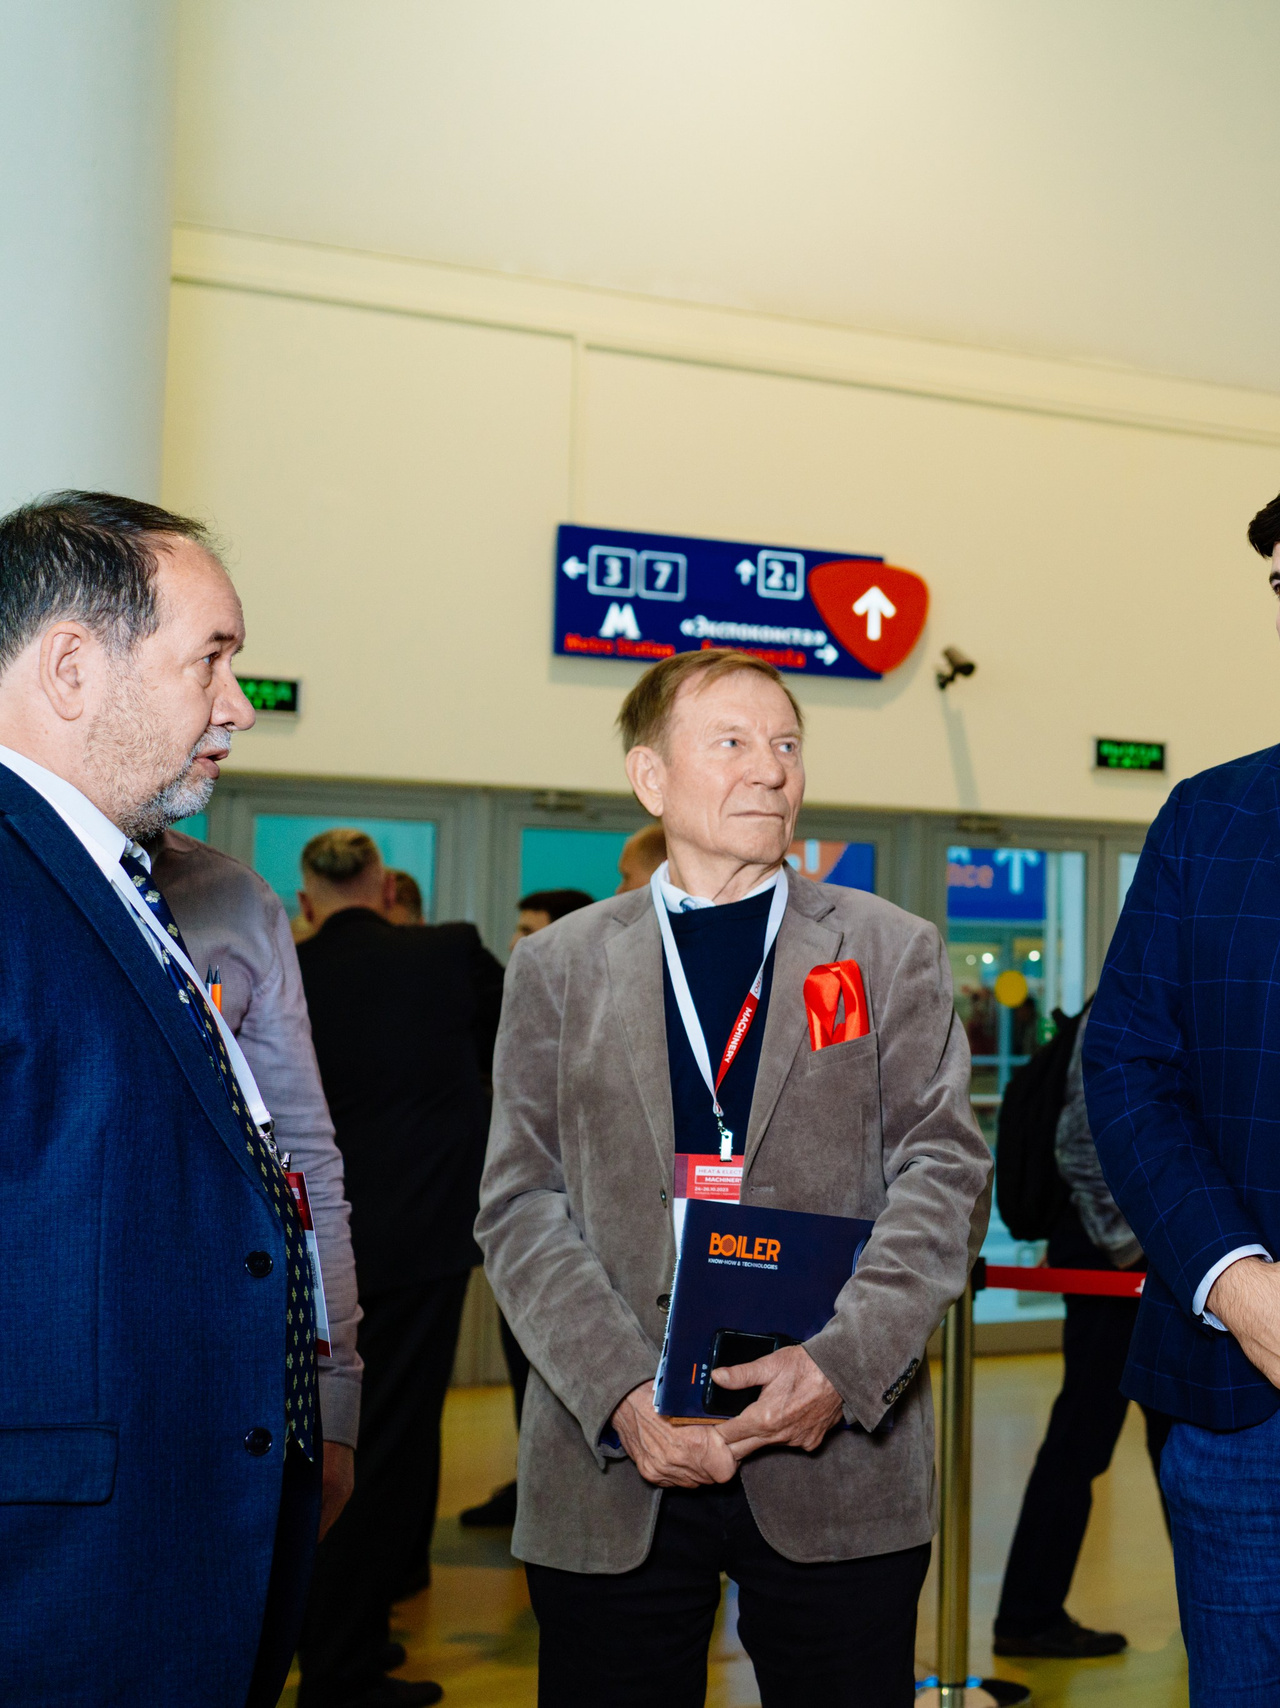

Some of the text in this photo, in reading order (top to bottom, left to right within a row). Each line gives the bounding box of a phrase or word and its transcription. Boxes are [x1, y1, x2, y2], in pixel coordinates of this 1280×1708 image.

[602, 556, 673, 590] 3 7
[724, 1006, 752, 1064] MACHINERY
[708, 1232, 781, 1262] BOILER
[707, 1257, 737, 1266] KNOW-HOW
[741, 1261, 778, 1271] TECHNOLOGIES
